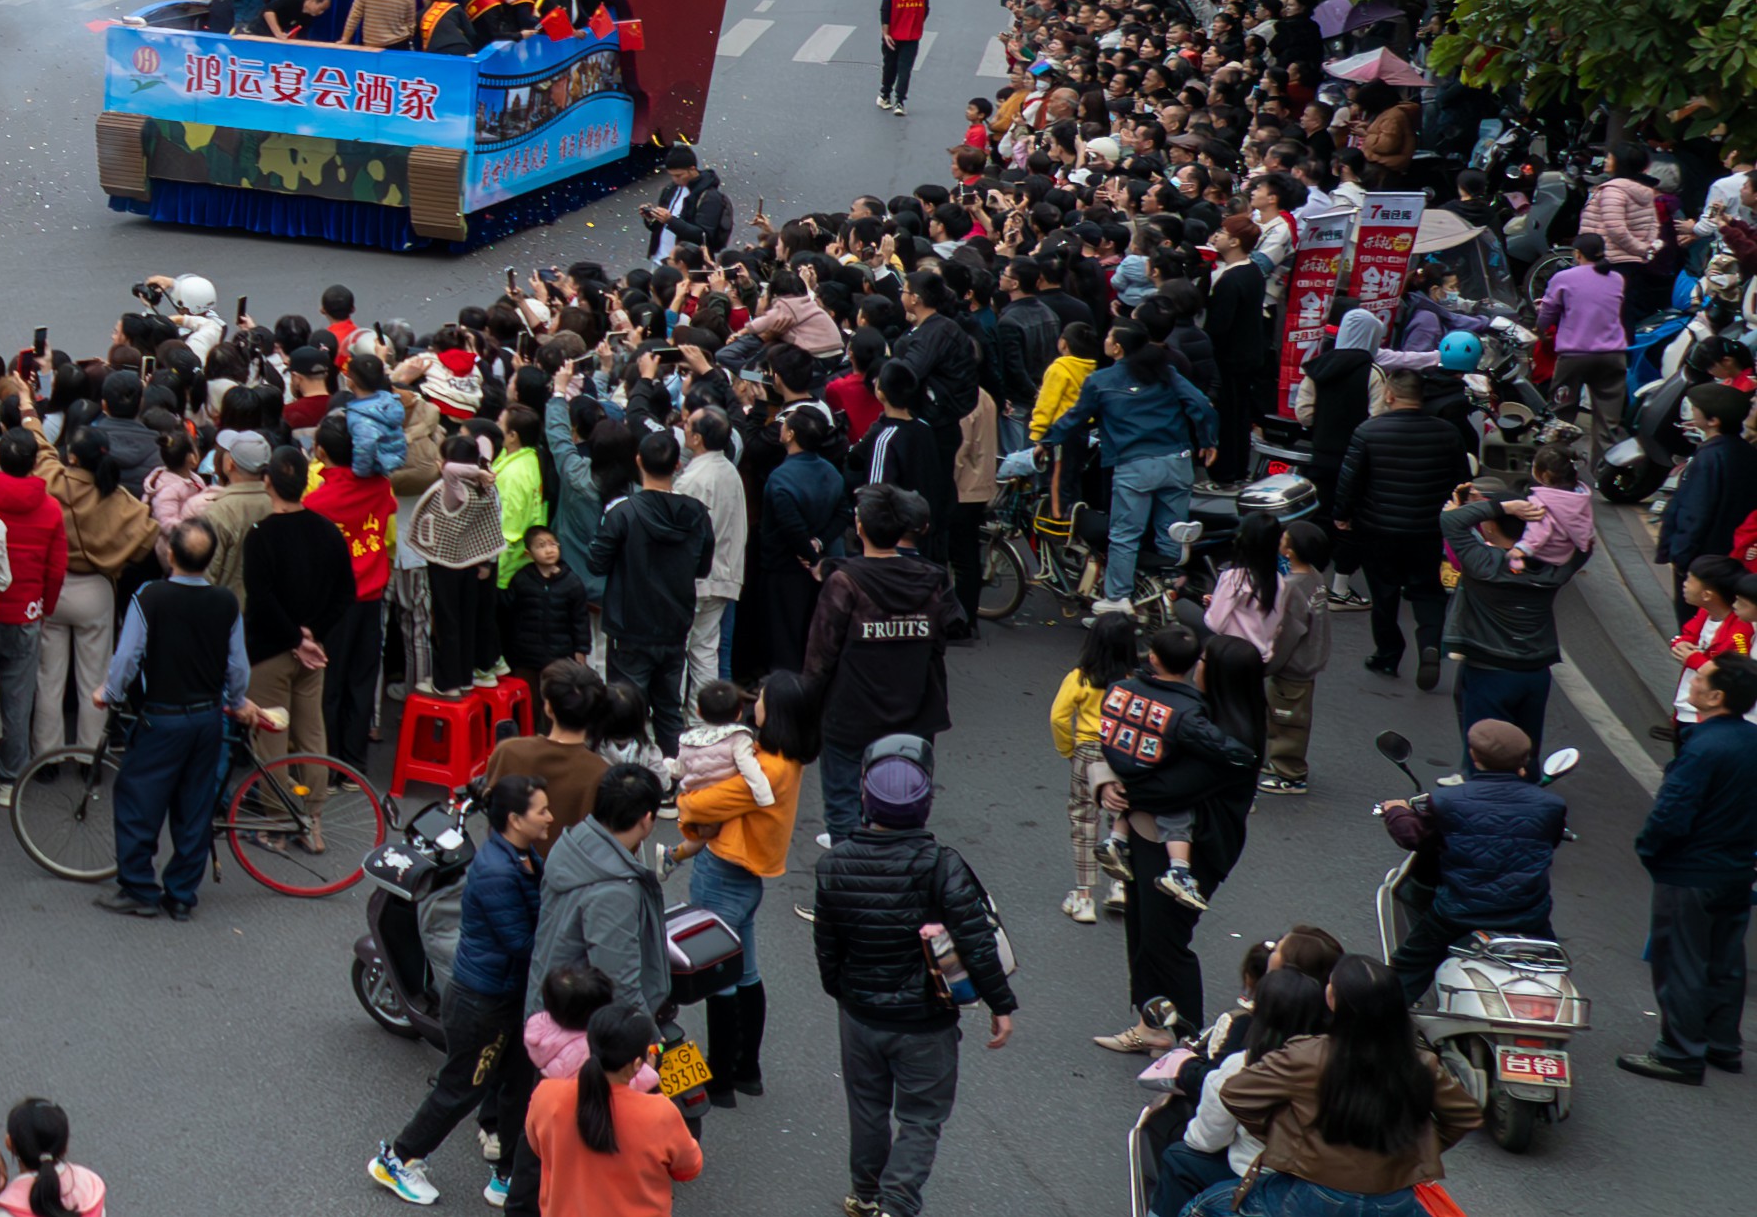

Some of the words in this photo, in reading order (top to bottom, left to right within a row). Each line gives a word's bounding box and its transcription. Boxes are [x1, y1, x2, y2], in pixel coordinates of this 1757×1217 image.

[185, 54, 440, 123] 鸿运宴会酒家
[1360, 266, 1402, 301] 全场
[862, 620, 929, 639] FRUITS
[661, 1061, 708, 1095] S9378
